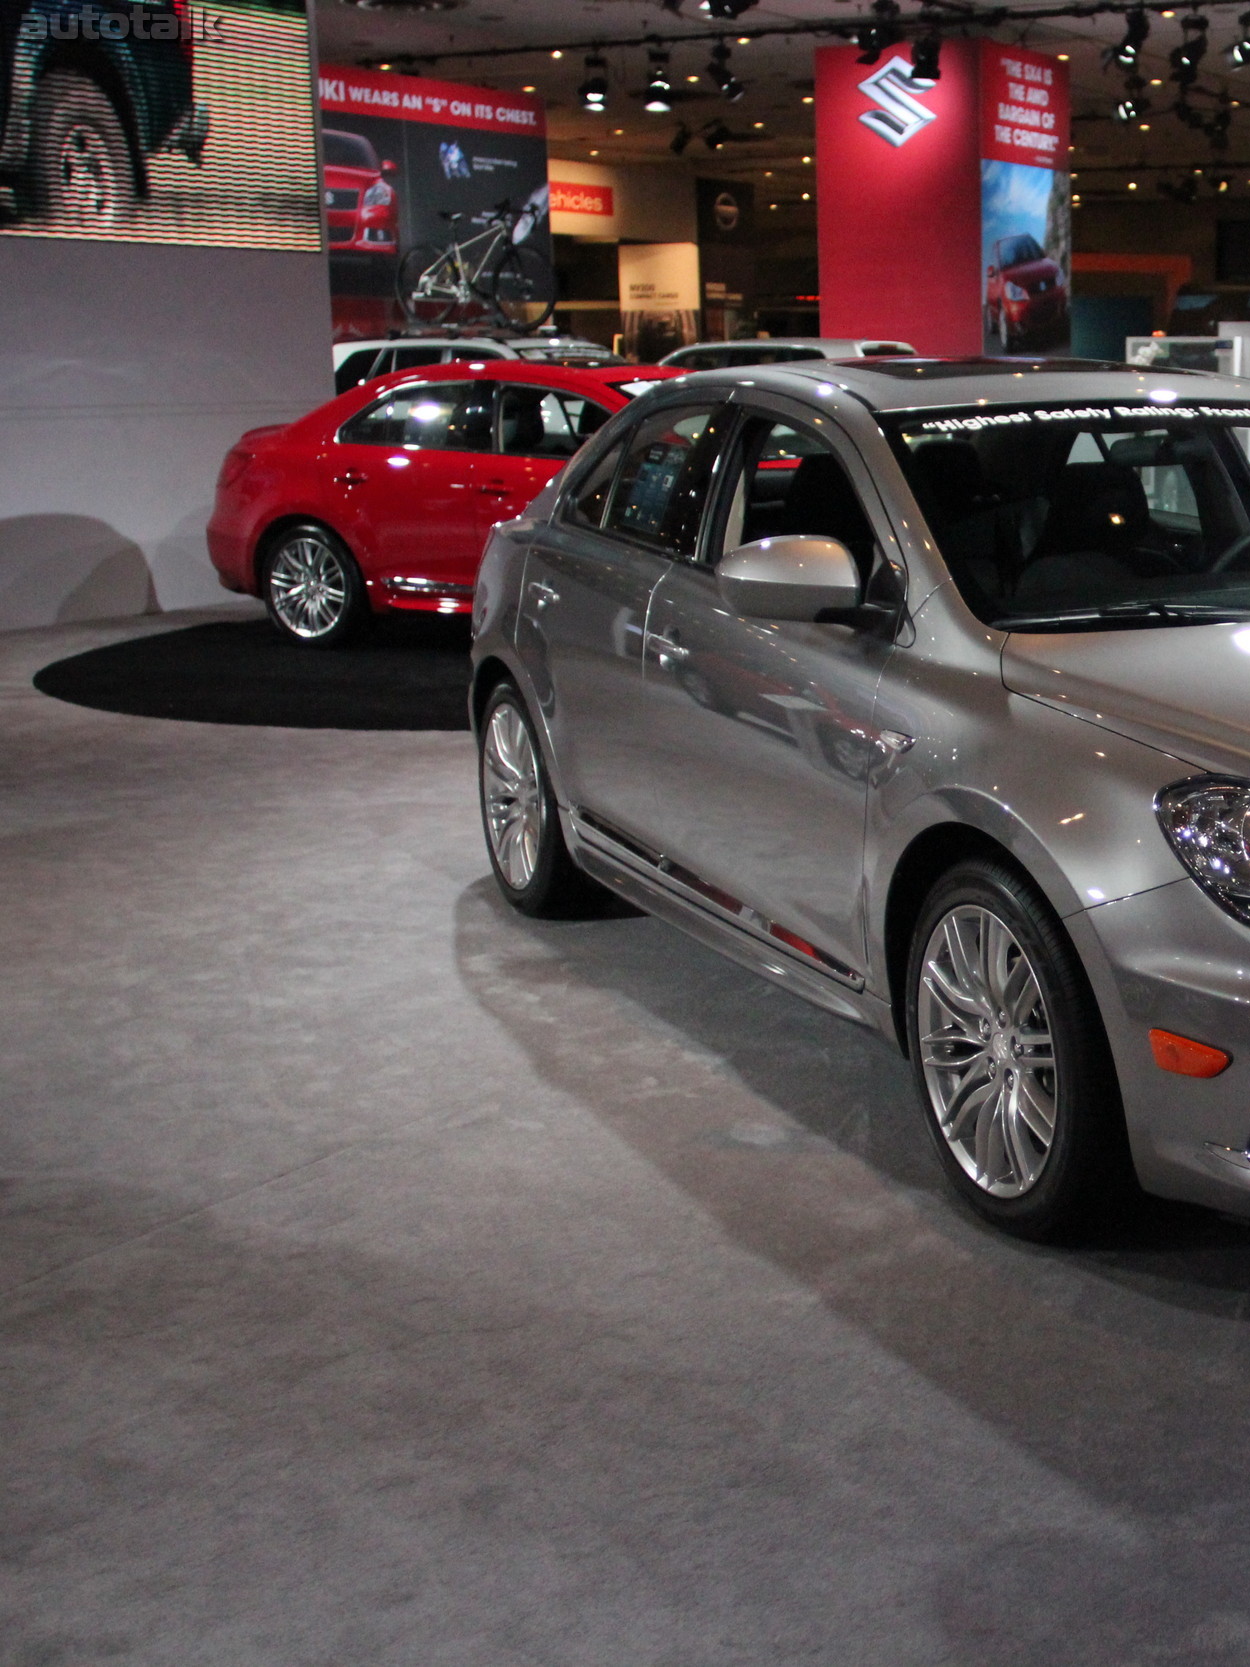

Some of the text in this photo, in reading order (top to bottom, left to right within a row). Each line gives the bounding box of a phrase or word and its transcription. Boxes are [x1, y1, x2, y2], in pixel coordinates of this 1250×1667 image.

[349, 86, 399, 107] WEARS
[402, 93, 423, 110] AN
[450, 100, 472, 117] ON
[474, 103, 493, 120] ITS
[495, 105, 537, 126] CHEST.
[1042, 112, 1055, 129] OF
[1033, 408, 1112, 420] Safety
[1113, 406, 1199, 418] Rating:
